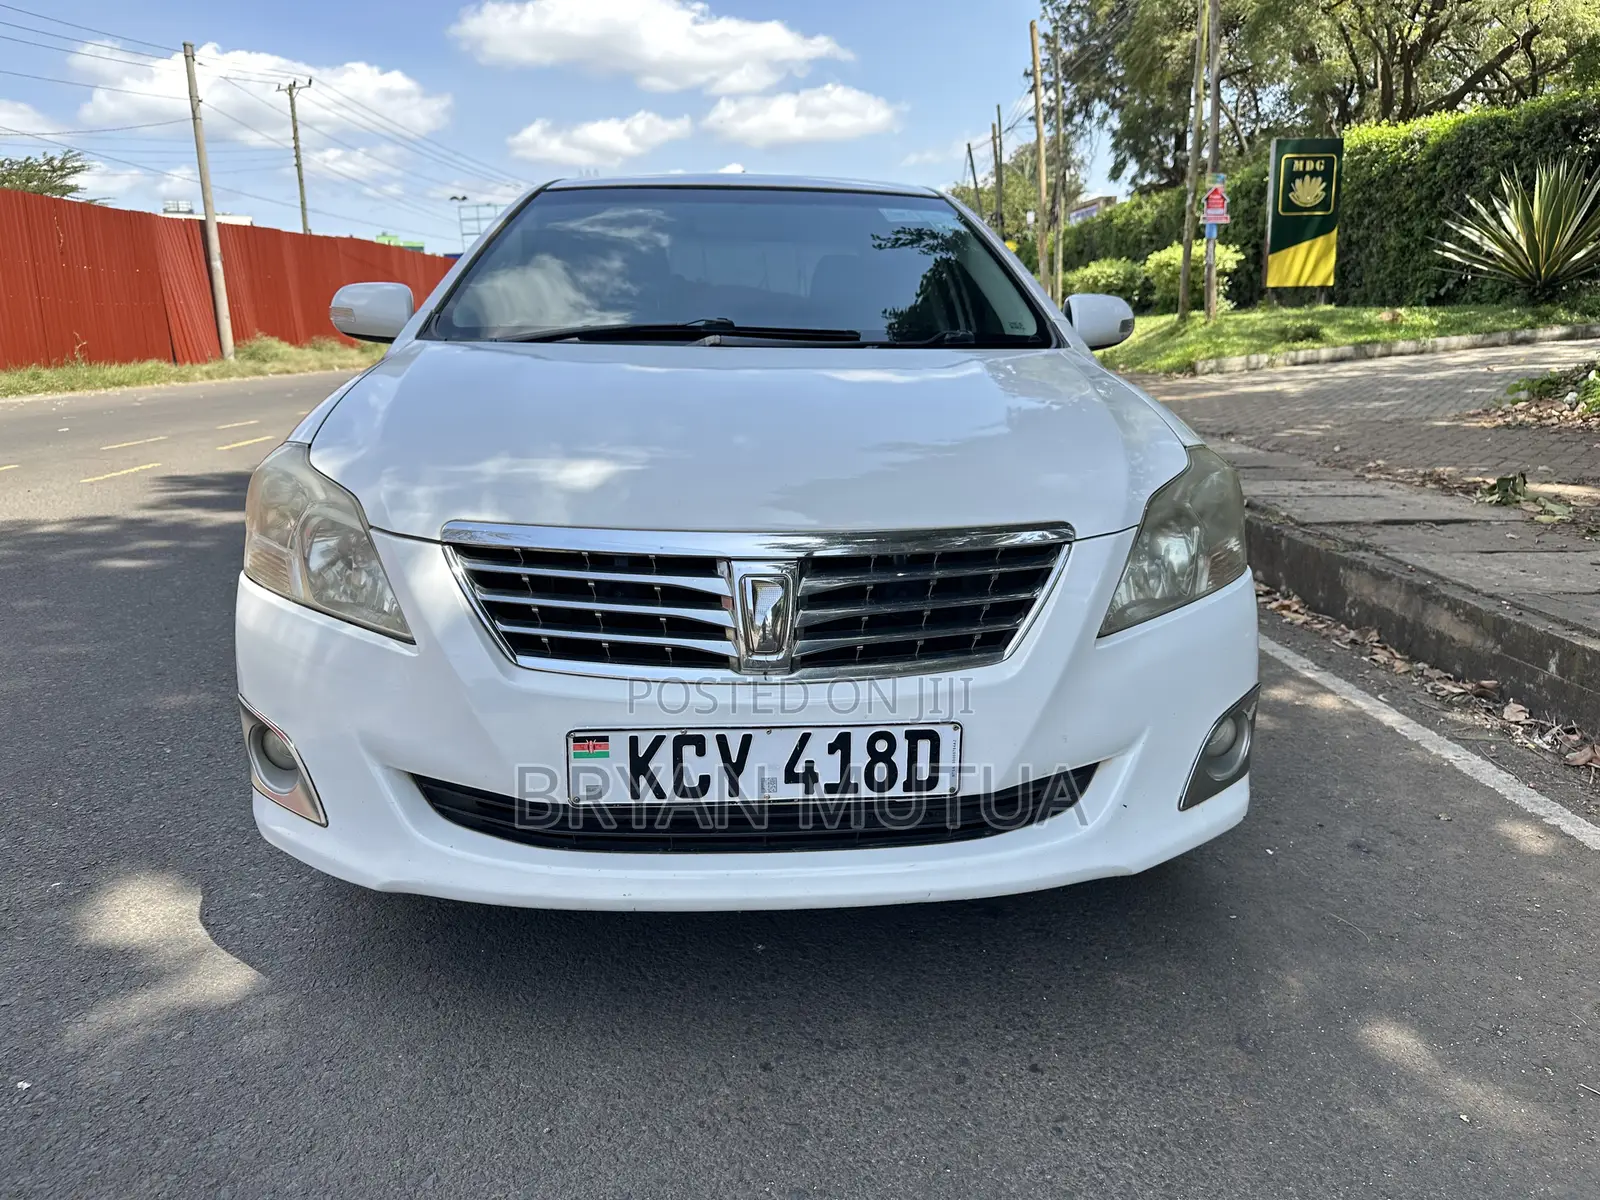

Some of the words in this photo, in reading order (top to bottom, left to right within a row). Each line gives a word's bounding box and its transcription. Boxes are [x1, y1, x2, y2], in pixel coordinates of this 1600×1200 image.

[1292, 159, 1325, 171] MDG
[628, 733, 753, 800] KCY
[783, 729, 941, 795] 418D
